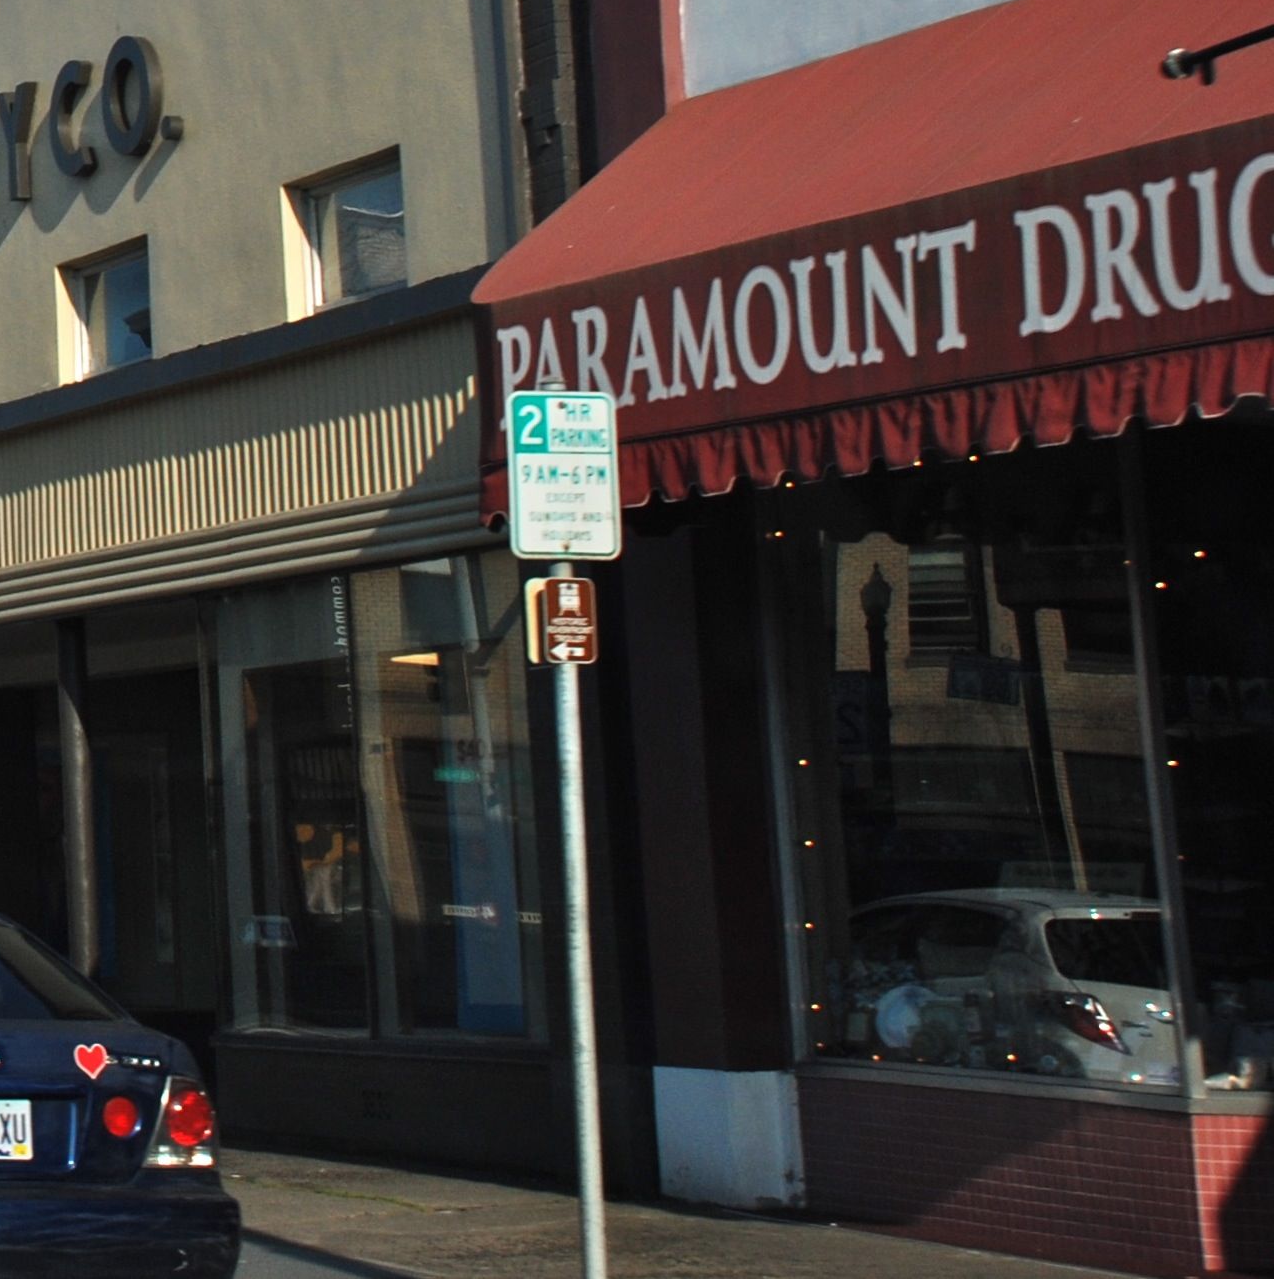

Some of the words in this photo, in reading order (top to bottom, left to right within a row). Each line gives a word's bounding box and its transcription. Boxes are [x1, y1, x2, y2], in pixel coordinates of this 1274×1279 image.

[496, 220, 975, 431] PARAMOUNT
[519, 405, 544, 445] 2
[565, 403, 591, 422] HR
[551, 429, 607, 448] PARKING
[585, 466, 607, 484] PM
[545, 493, 586, 503] EXCEPT
[529, 511, 577, 522] SUNDAYS
[579, 512, 603, 522] AND
[541, 531, 593, 541] HOLIDAYS
